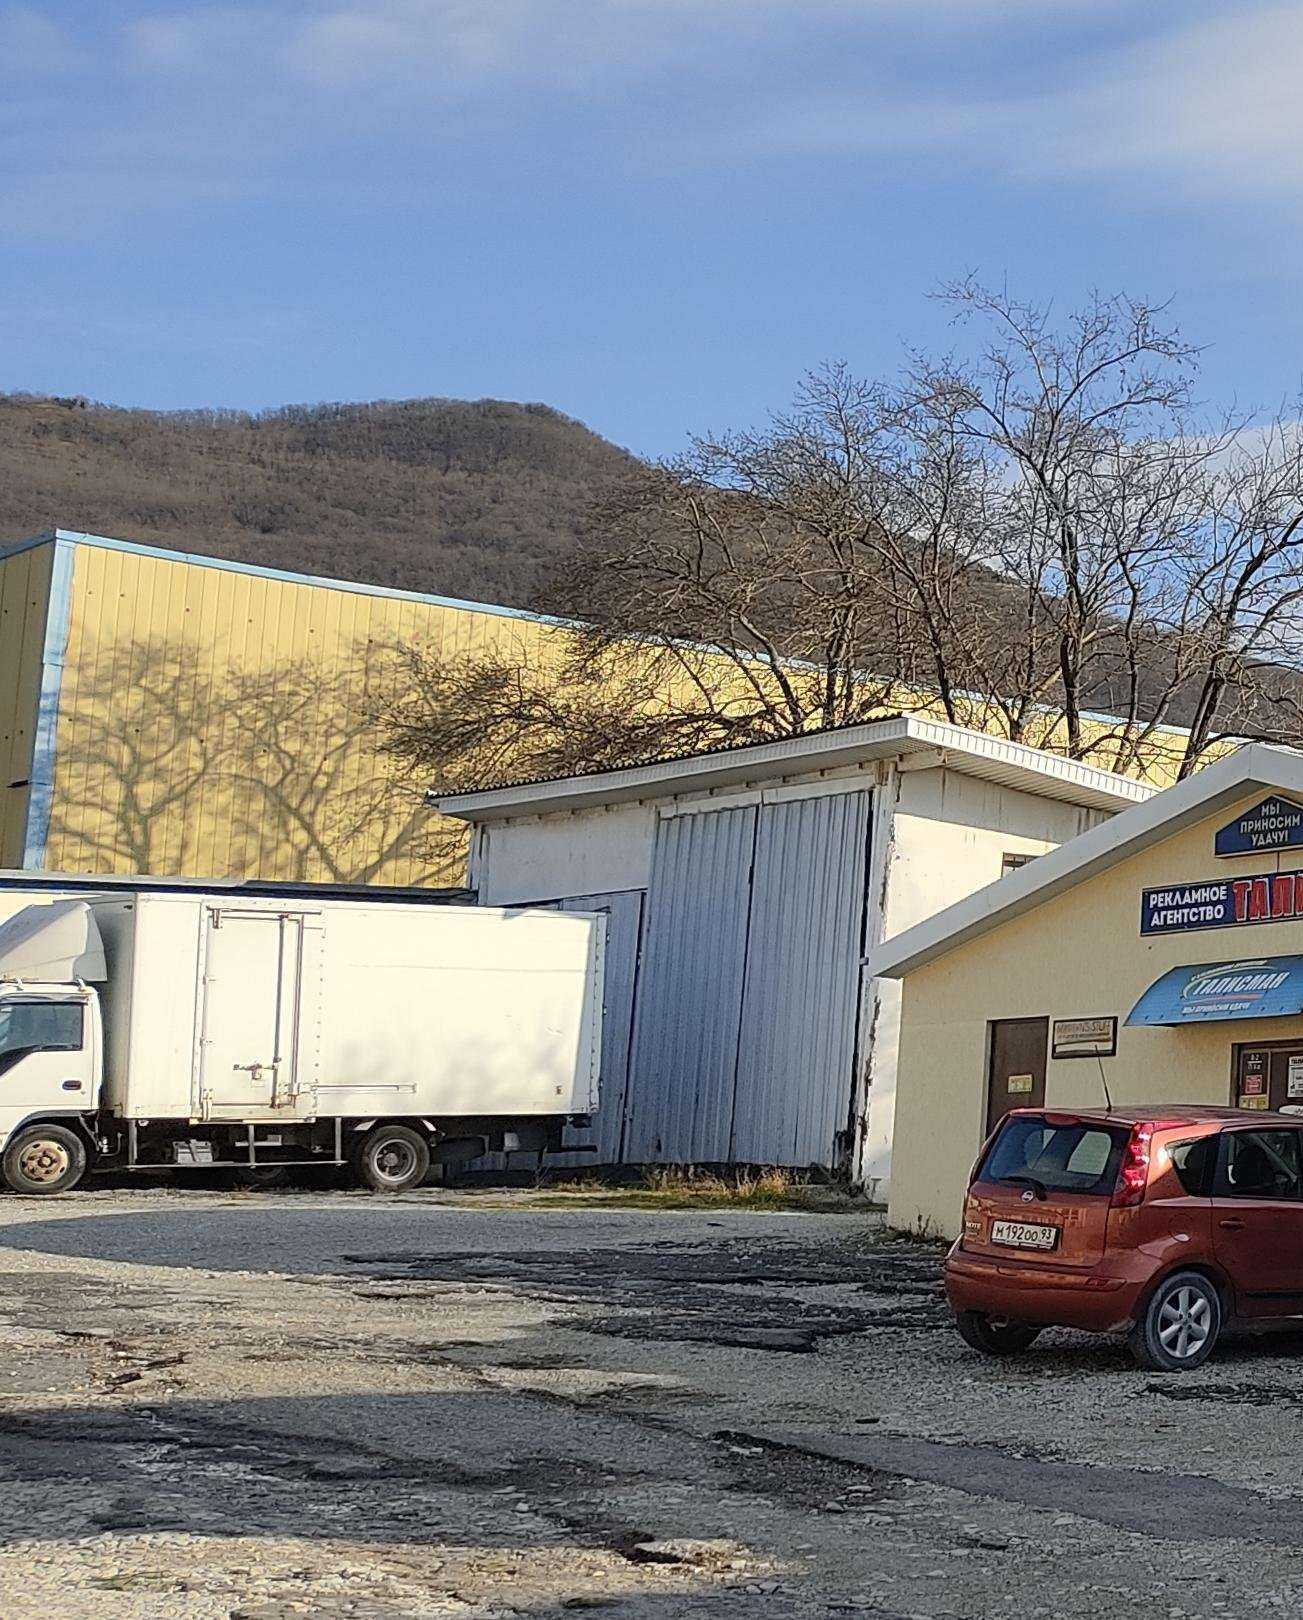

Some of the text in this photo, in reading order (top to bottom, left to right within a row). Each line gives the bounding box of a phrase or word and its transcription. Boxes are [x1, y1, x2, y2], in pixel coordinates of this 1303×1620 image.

[1261, 802, 1280, 816] МЫ
[1240, 814, 1301, 834] ПРИНОСИМ
[1251, 830, 1289, 847] УДАЧУ!
[1149, 885, 1228, 909] РЕКЛАМНОЕ
[1150, 905, 1225, 928] АГЕНТСТВО
[1192, 971, 1291, 996] ТАЛИСМАН
